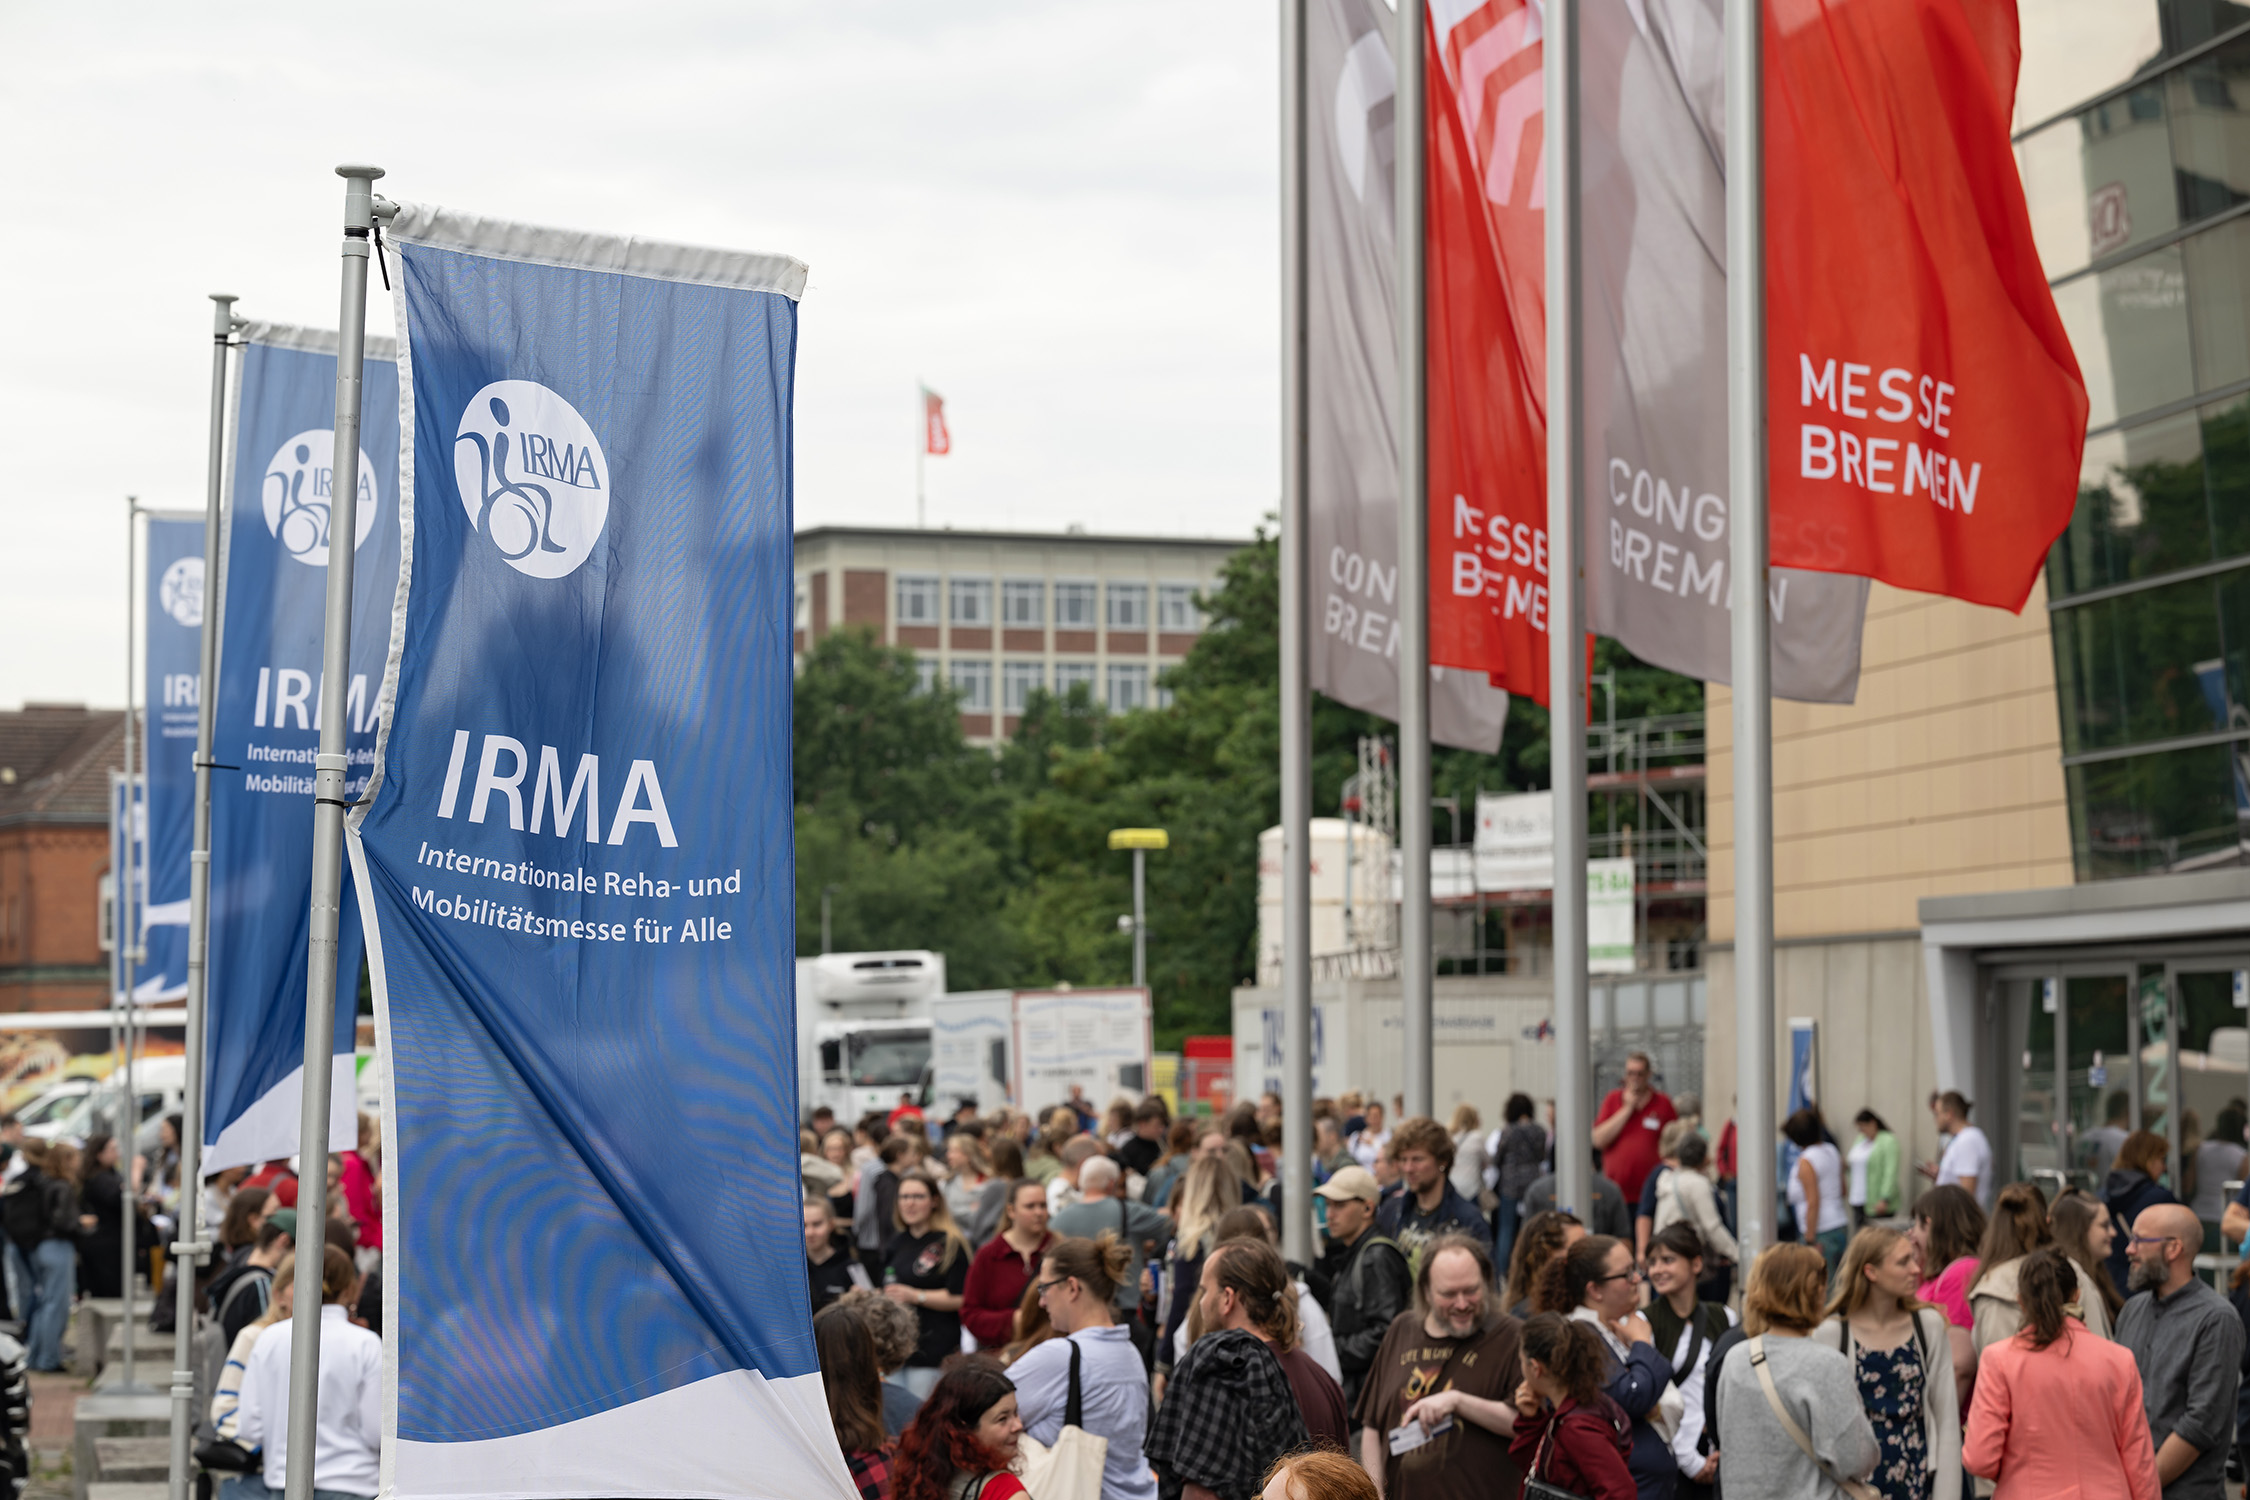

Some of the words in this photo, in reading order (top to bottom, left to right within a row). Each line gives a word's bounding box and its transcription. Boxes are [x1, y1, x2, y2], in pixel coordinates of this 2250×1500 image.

[1800, 353, 1955, 438] MESSE
[313, 467, 372, 501] IRA
[520, 432, 601, 490] IRMA
[1801, 424, 1981, 515] BREMEN
[1610, 517, 1788, 624] BREMN
[437, 730, 679, 847] IRMA
[417, 841, 597, 894] Internationale
[604, 872, 681, 898] Reha-
[688, 869, 741, 897] und
[411, 886, 627, 942] Mobilitätsmesse
[633, 917, 673, 943] für
[680, 917, 732, 943] Alle
